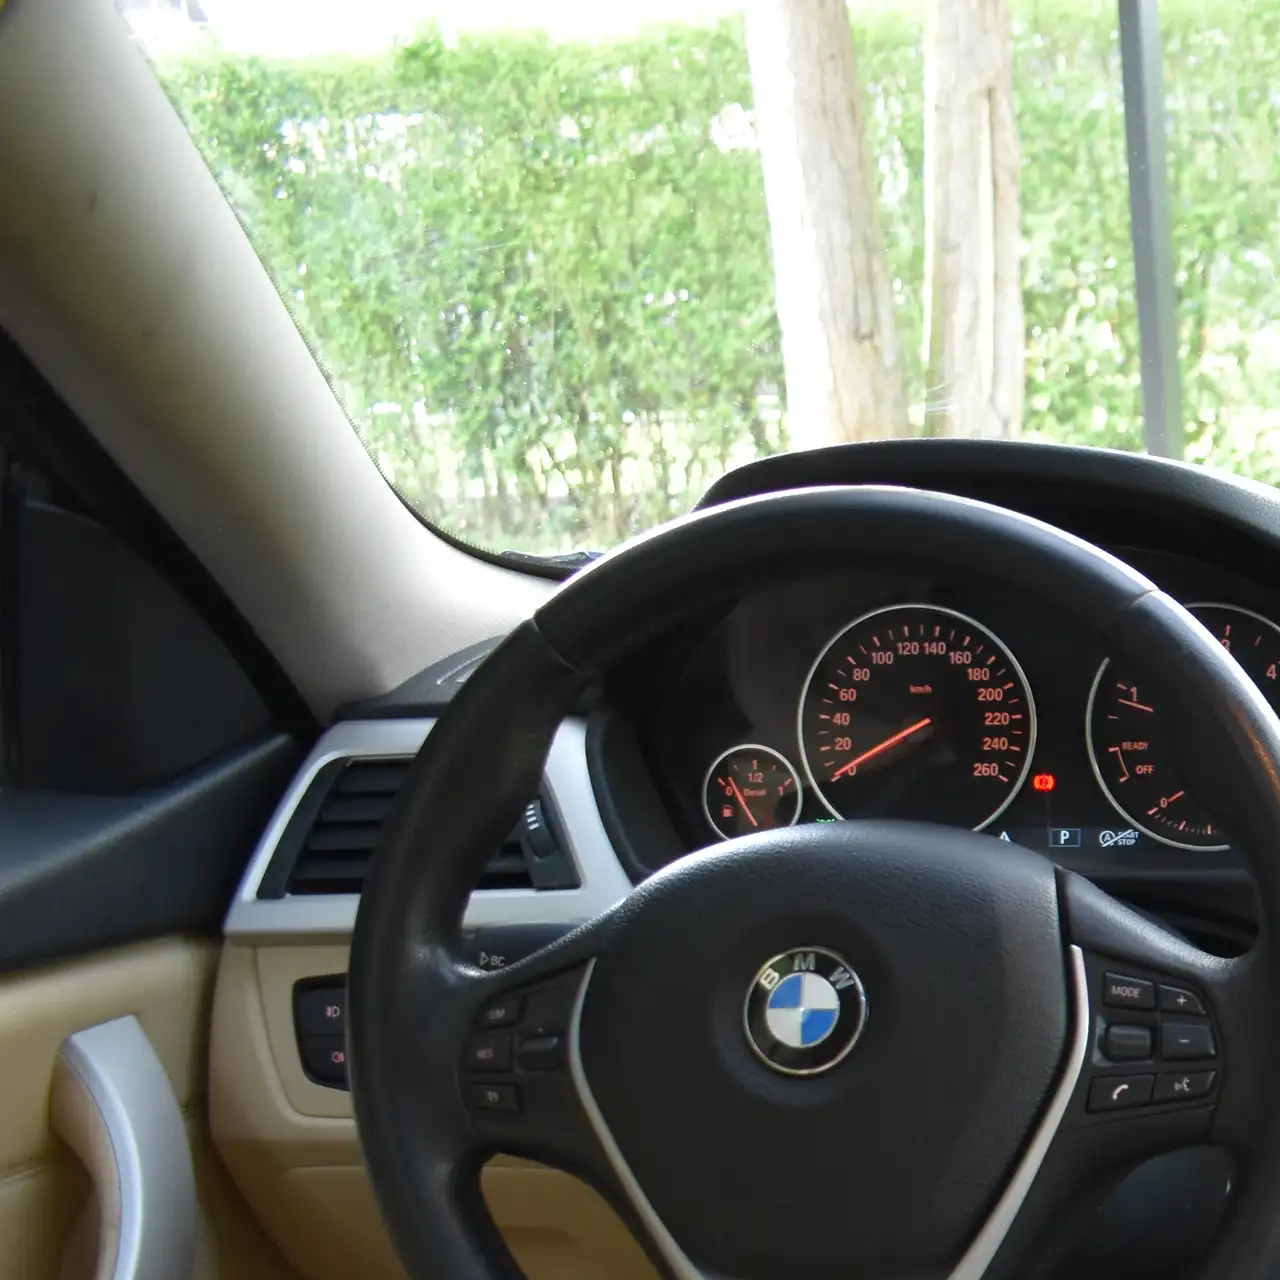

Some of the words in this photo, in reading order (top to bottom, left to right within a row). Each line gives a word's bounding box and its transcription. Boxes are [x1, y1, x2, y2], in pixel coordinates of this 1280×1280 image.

[897, 641, 919, 655] 120
[924, 641, 946, 655] 140
[872, 651, 894, 665] 100
[950, 651, 972, 665] 160
[853, 668, 870, 682] 80
[967, 668, 990, 682] 180
[1266, 663, 1278, 680] 4
[839, 688, 857, 702] 60
[978, 688, 1003, 702] 200
[1130, 686, 1138, 701] 1
[832, 712, 850, 725] 40
[984, 712, 1010, 725] 220
[835, 737, 852, 751] 20
[983, 737, 1008, 751] 240
[1122, 741, 1149, 751] READY
[973, 763, 998, 776] 260
[1135, 765, 1155, 775] OFF
[748, 772, 765, 783] 1/2
[726, 786, 733, 797] 0
[1160, 796, 1168, 808] 0
[1060, 830, 1070, 844] P
[490, 956, 506, 967] BC
[758, 952, 856, 991] BMW
[1111, 984, 1142, 999] MODE
